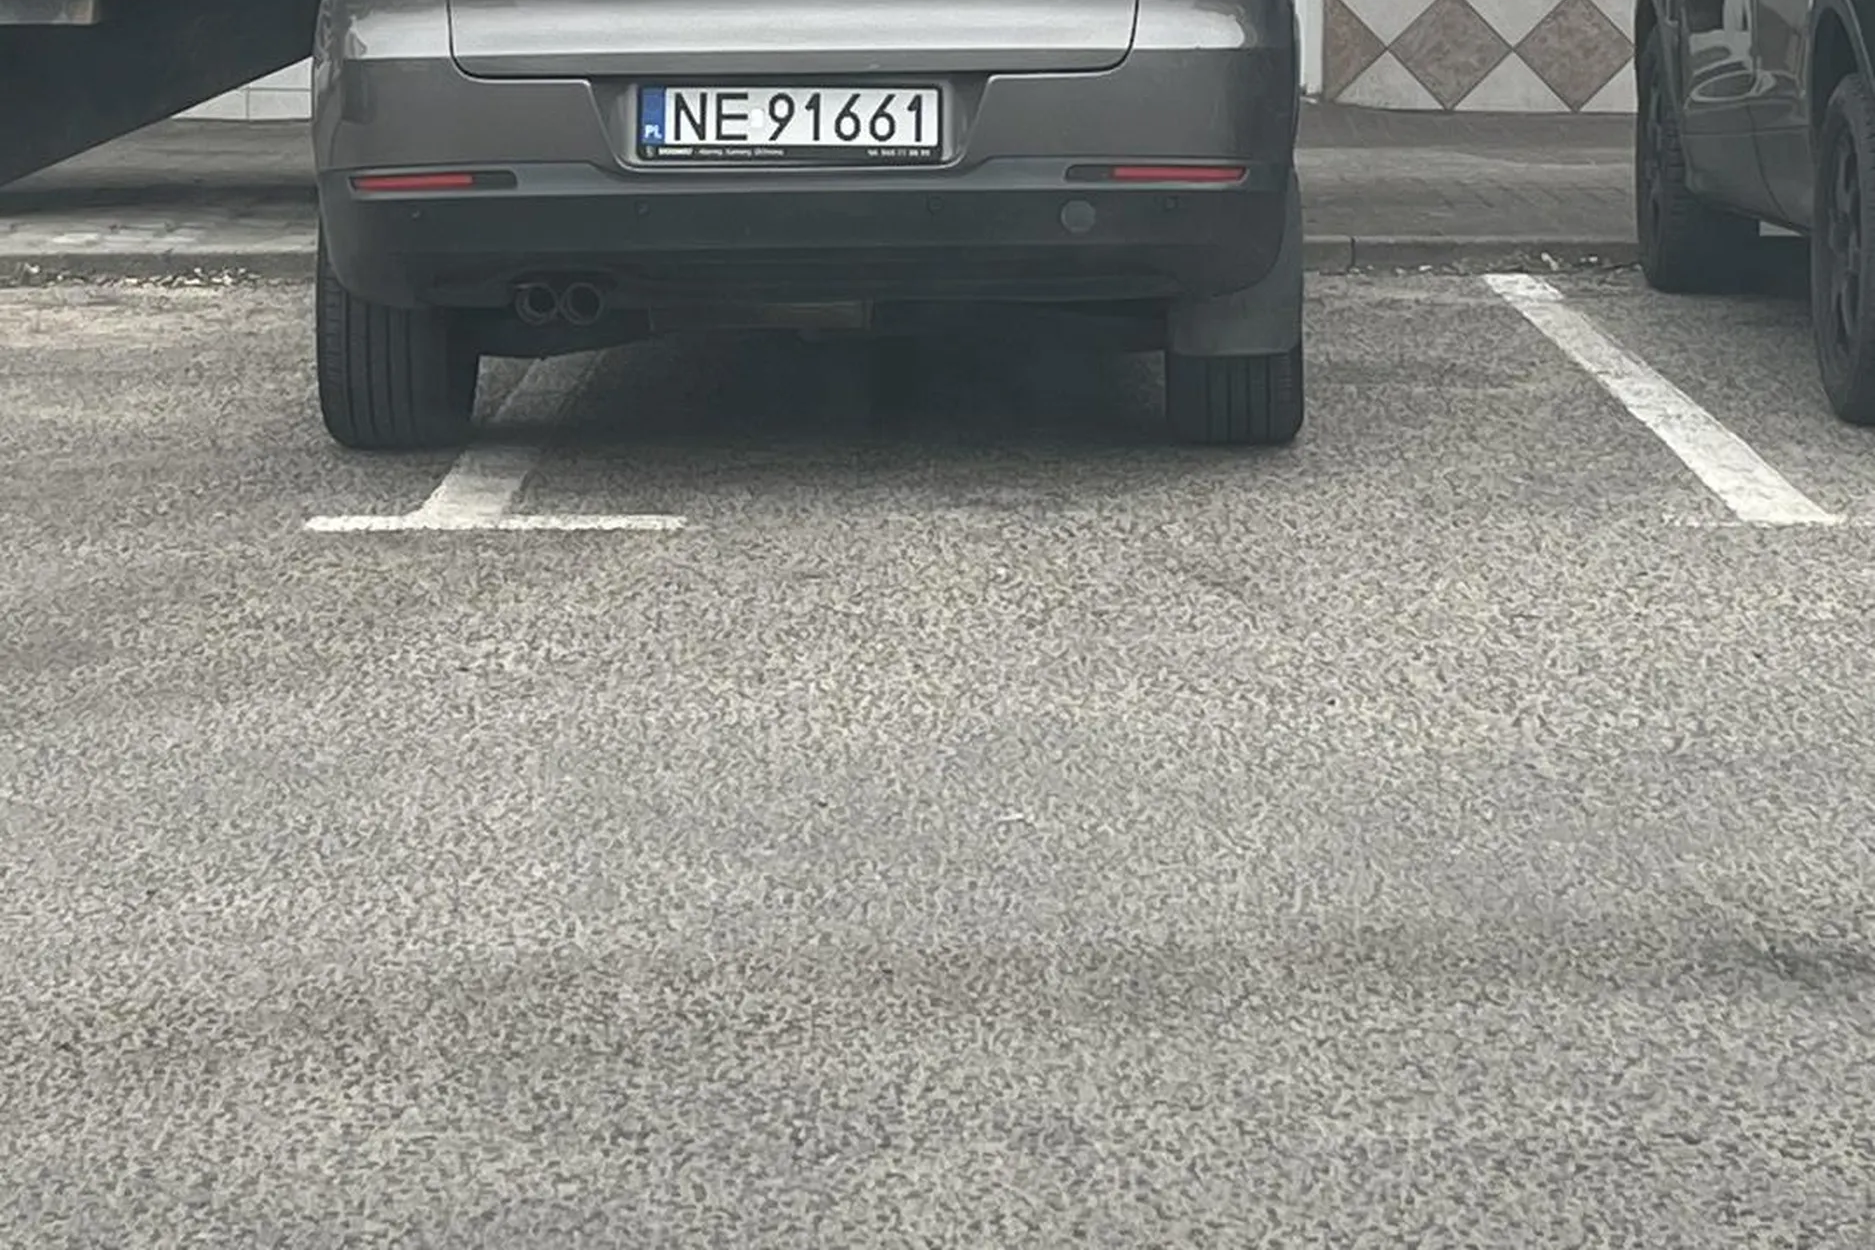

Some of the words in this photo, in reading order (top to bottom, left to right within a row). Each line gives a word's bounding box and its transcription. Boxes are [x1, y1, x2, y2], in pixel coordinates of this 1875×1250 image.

[644, 124, 663, 140] PL
[673, 92, 749, 142] NE
[768, 91, 923, 143] 91661
